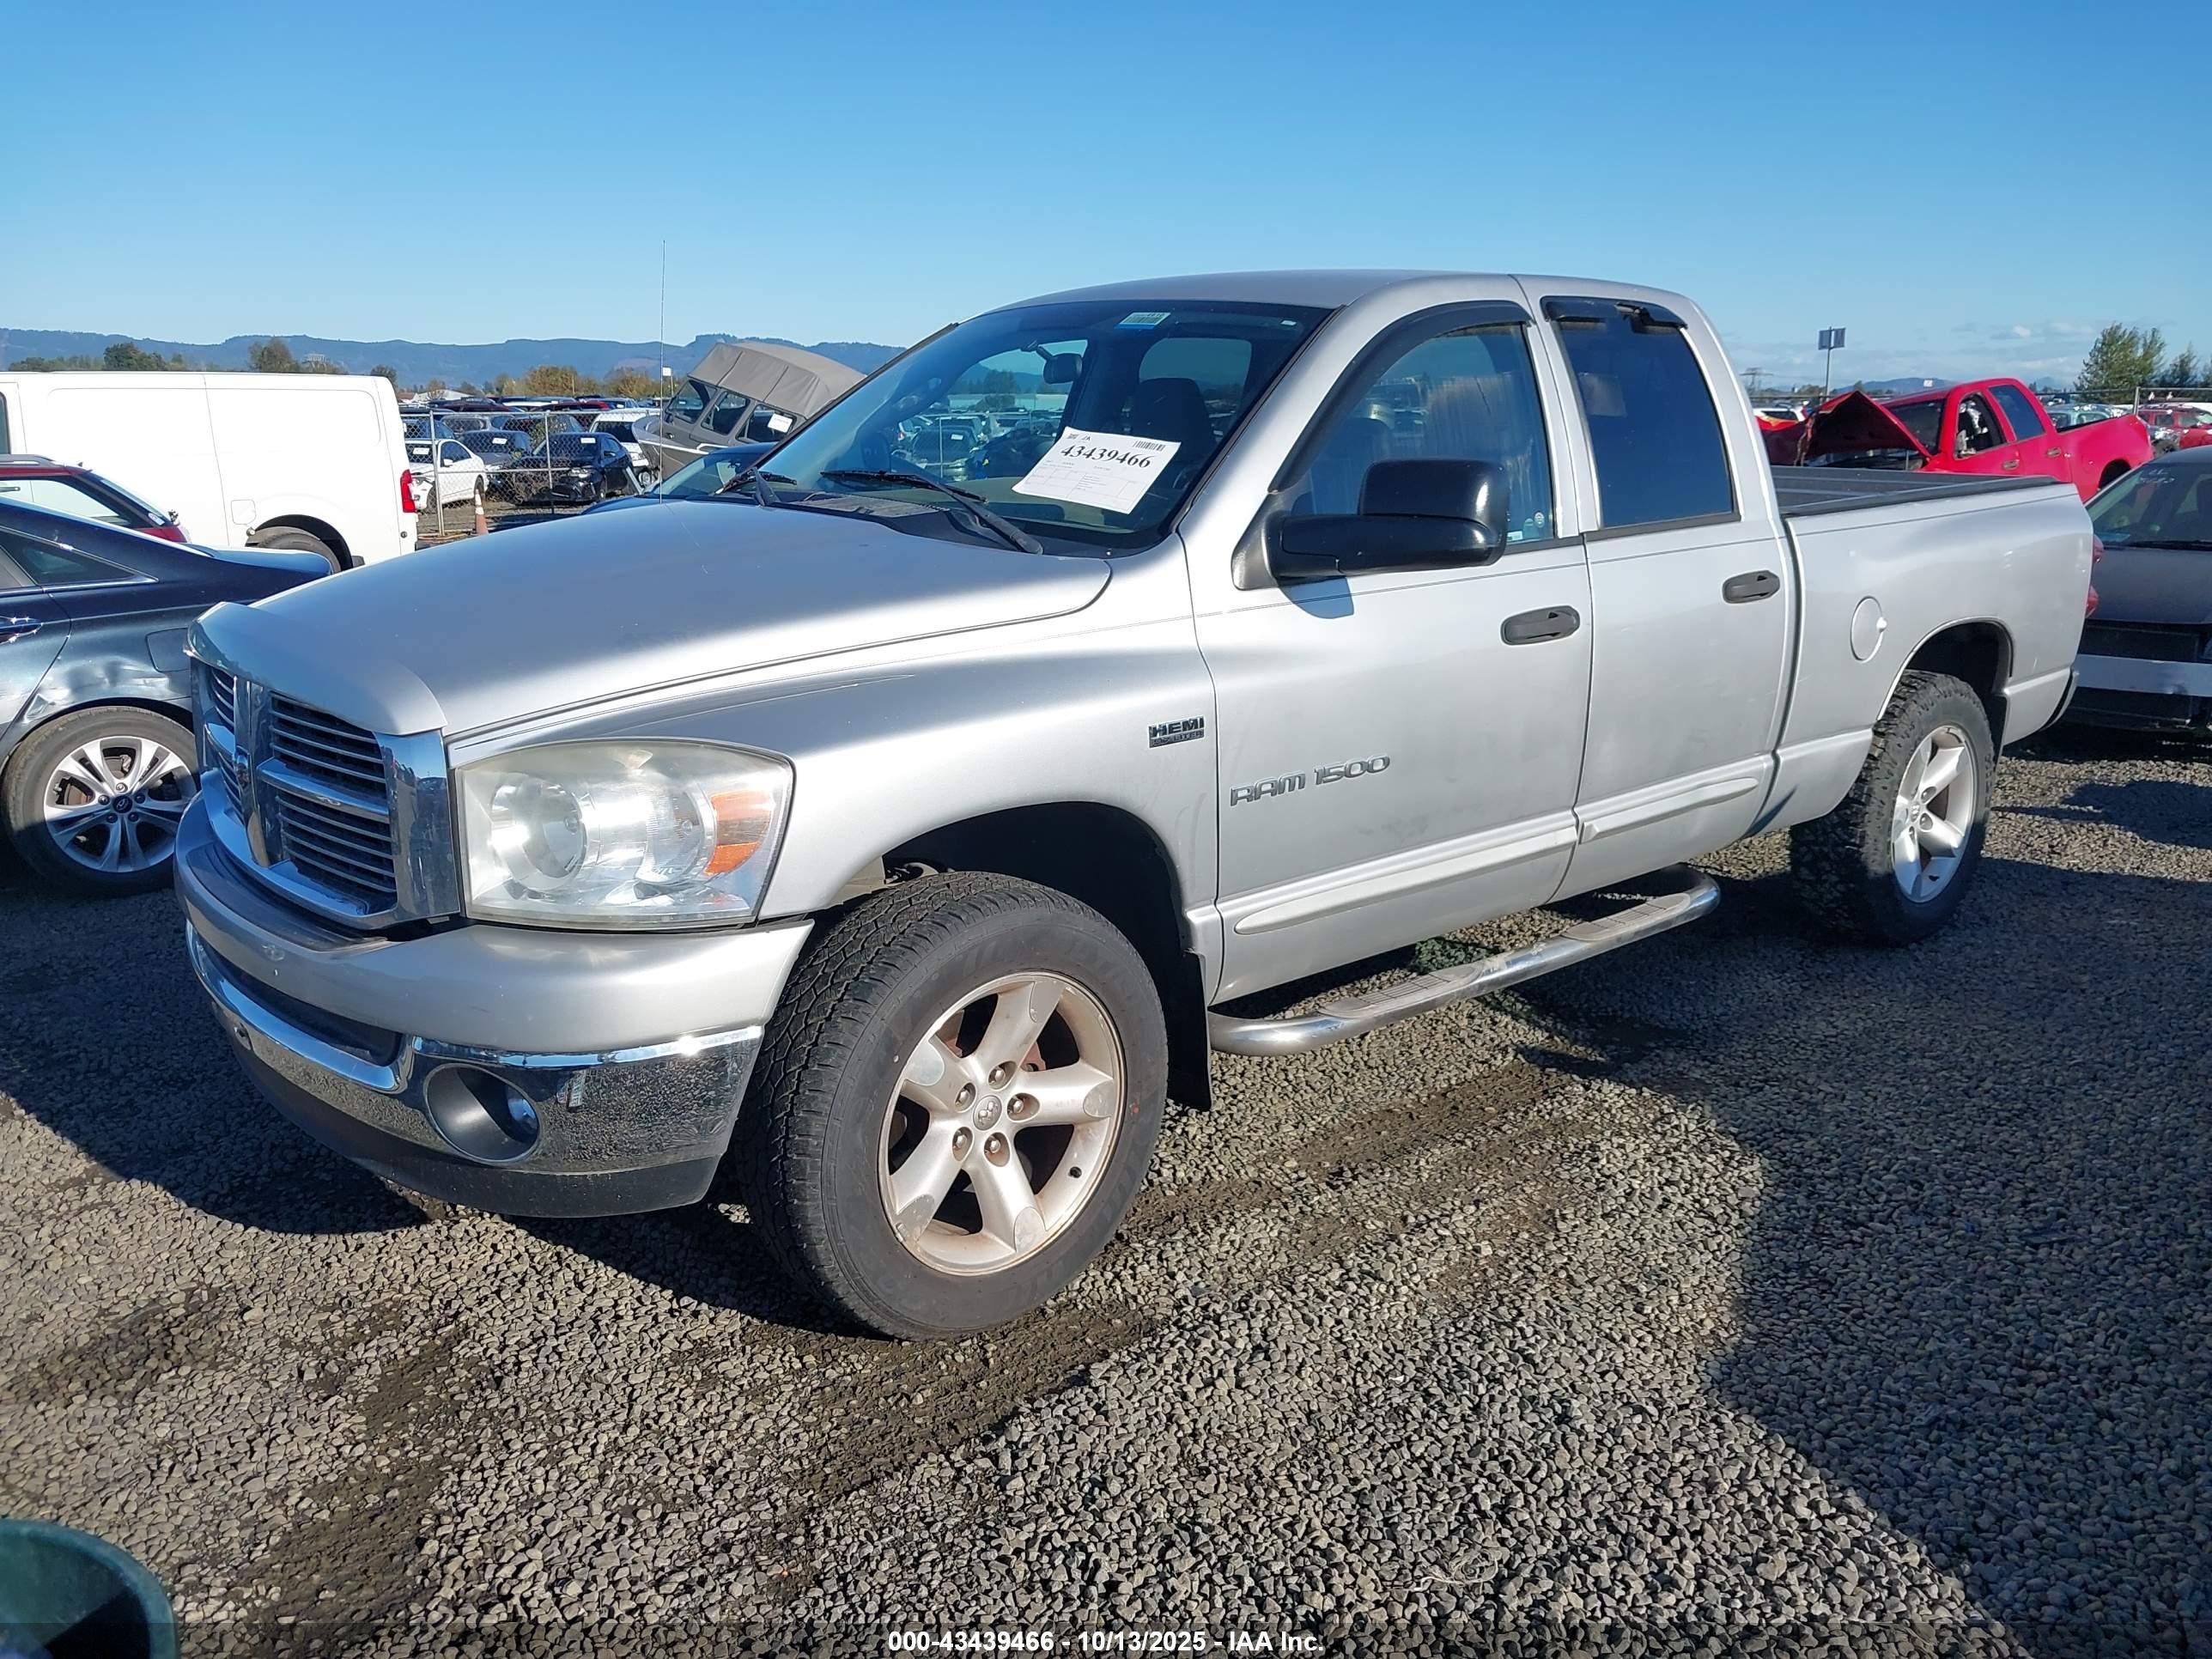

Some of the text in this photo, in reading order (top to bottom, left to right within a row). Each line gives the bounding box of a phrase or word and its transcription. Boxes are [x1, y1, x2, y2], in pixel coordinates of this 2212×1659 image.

[1060, 445, 1155, 468] 43439466
[1149, 717, 1204, 738] HEMI
[1230, 756, 1390, 806] RAM 1500
